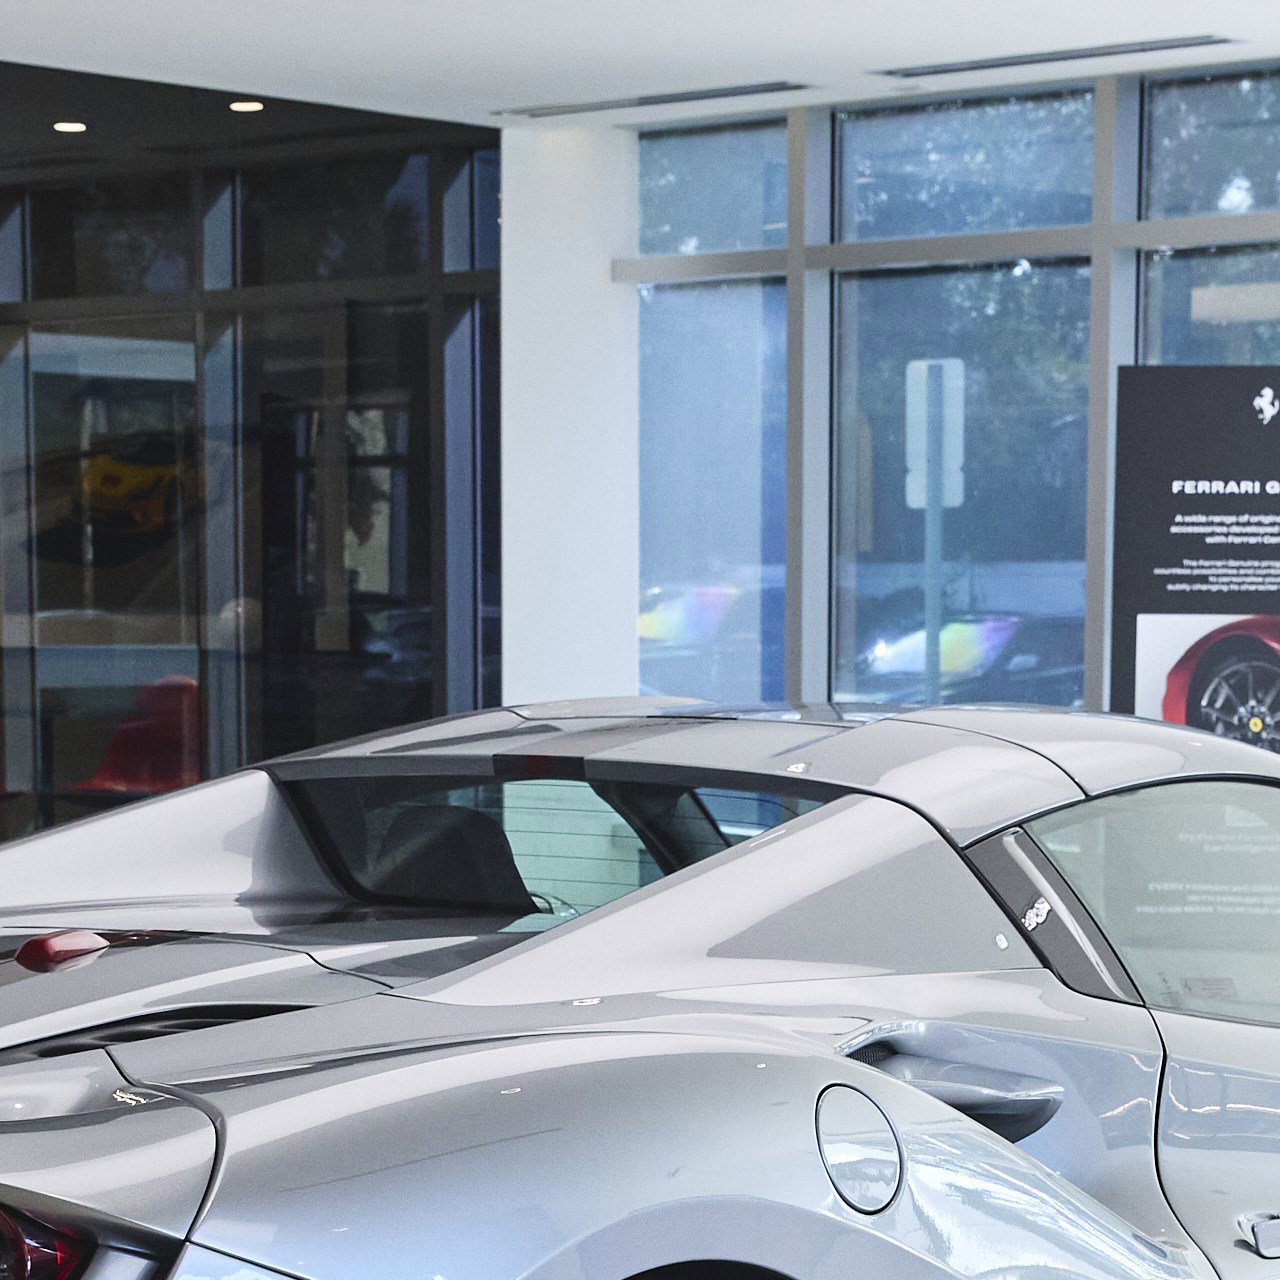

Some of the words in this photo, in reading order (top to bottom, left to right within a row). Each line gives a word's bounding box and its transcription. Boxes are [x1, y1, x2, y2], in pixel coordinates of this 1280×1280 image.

[1172, 480, 1261, 494] FERRARI
[1174, 514, 1183, 524] A
[1238, 514, 1249, 524] of
